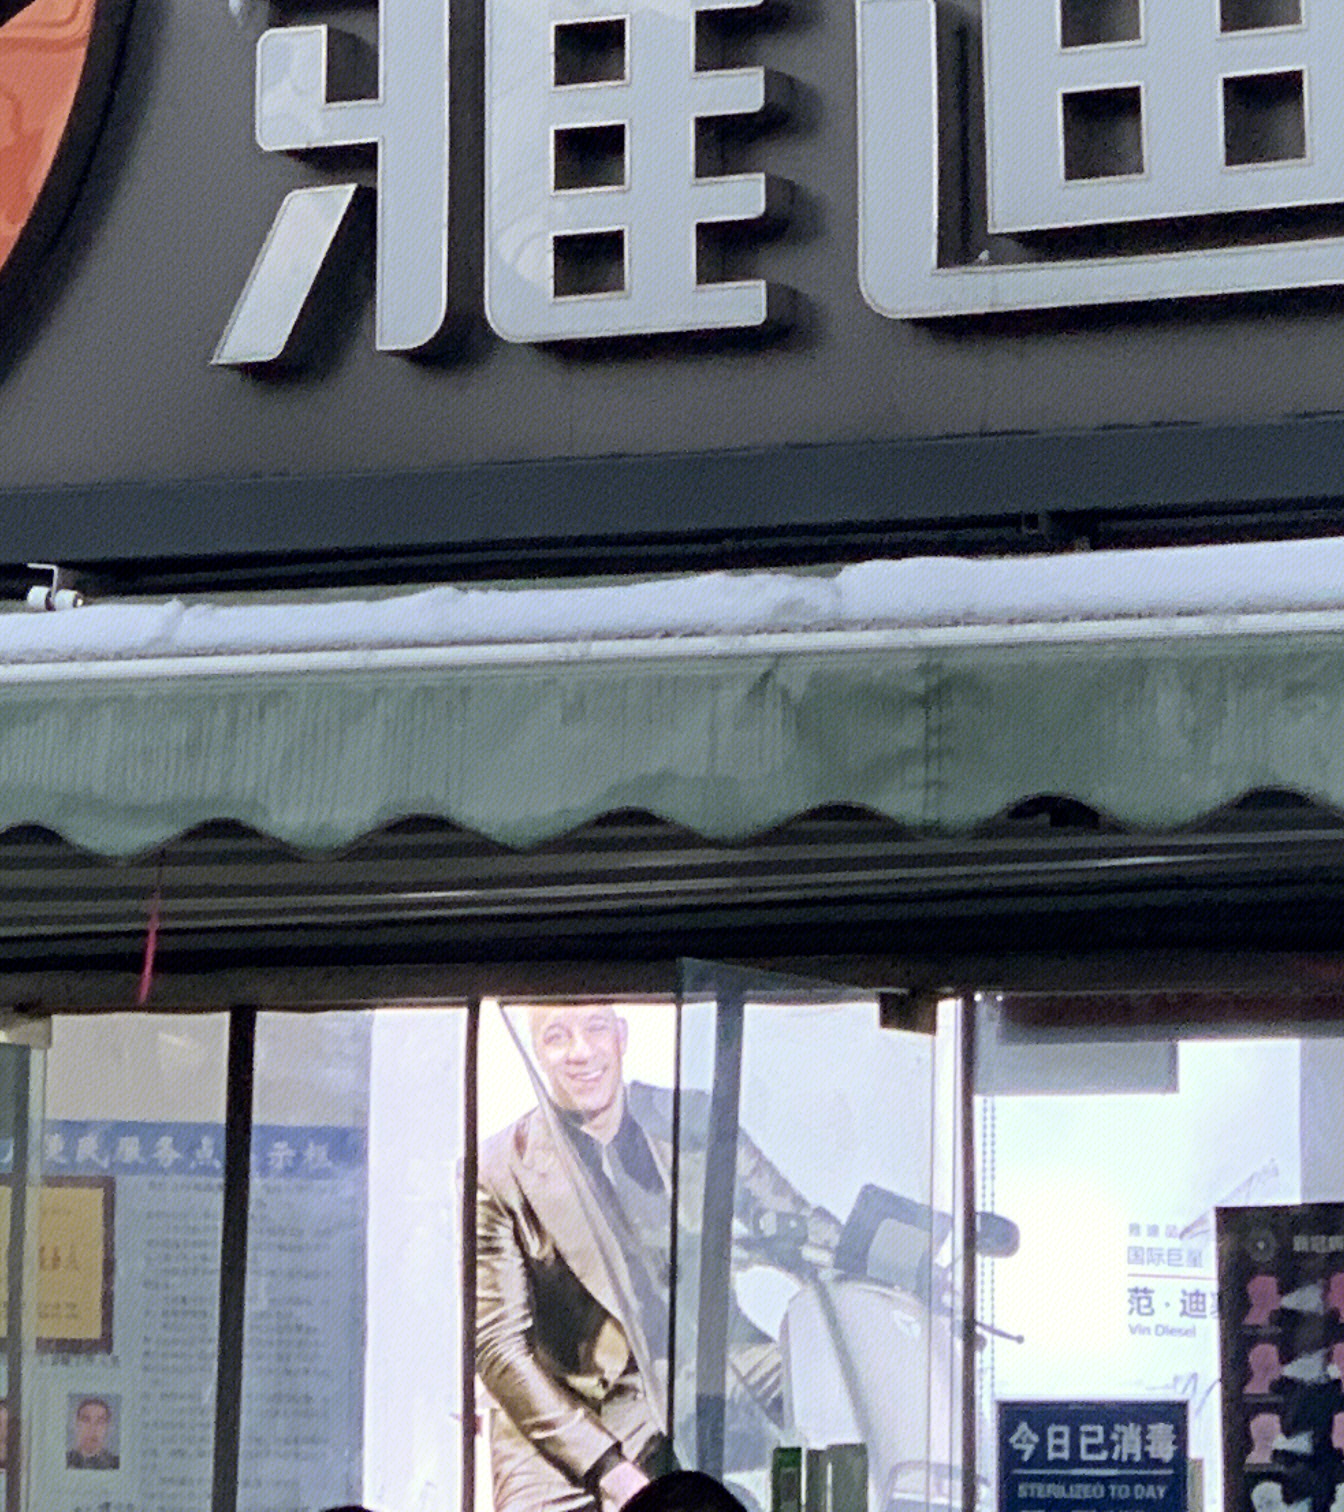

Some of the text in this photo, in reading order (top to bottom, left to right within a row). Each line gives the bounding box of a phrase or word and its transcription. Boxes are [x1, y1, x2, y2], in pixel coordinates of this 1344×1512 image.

[1127, 1287, 1217, 1319] 范·迪
[1009, 1422, 1178, 1463] 今日已消毒
